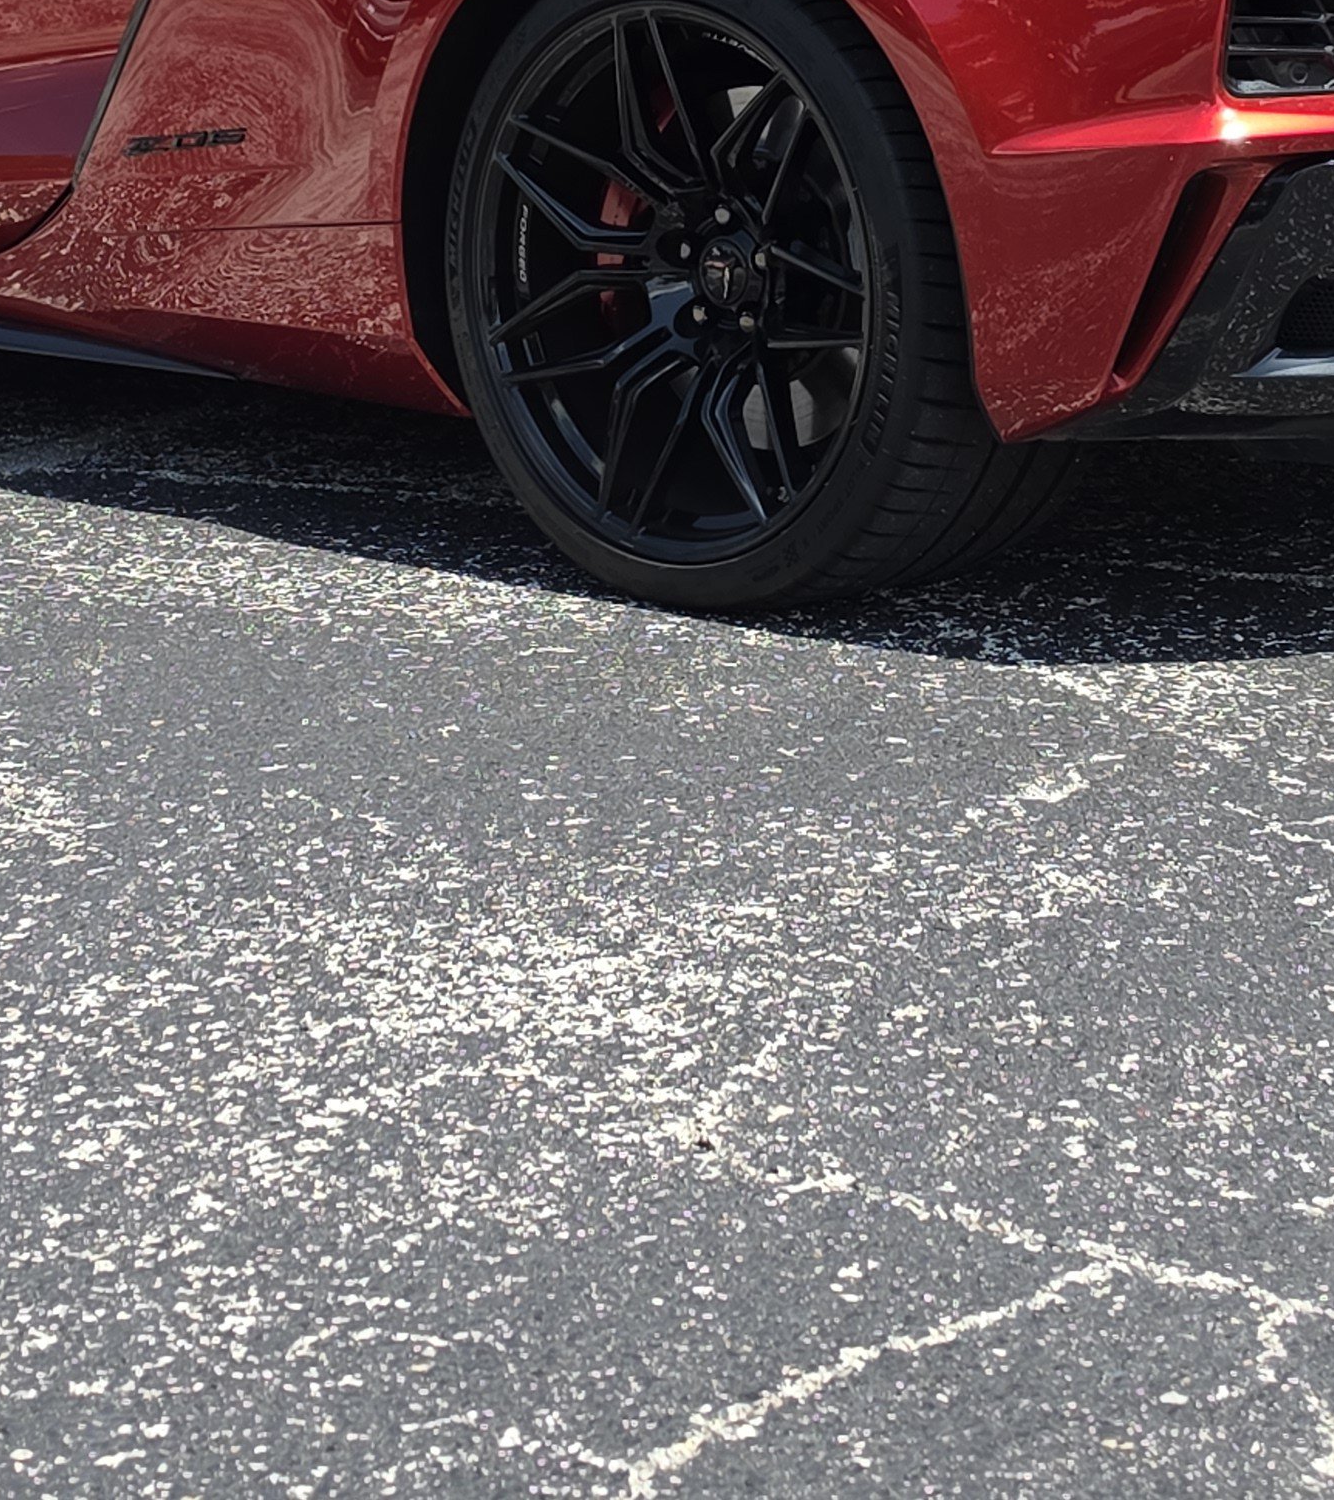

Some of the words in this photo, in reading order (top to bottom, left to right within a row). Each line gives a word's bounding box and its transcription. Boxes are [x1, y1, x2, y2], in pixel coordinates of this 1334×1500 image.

[124, 128, 247, 157] Z06
[519, 204, 529, 283] FORGED
[862, 289, 901, 453] MICHELIN
